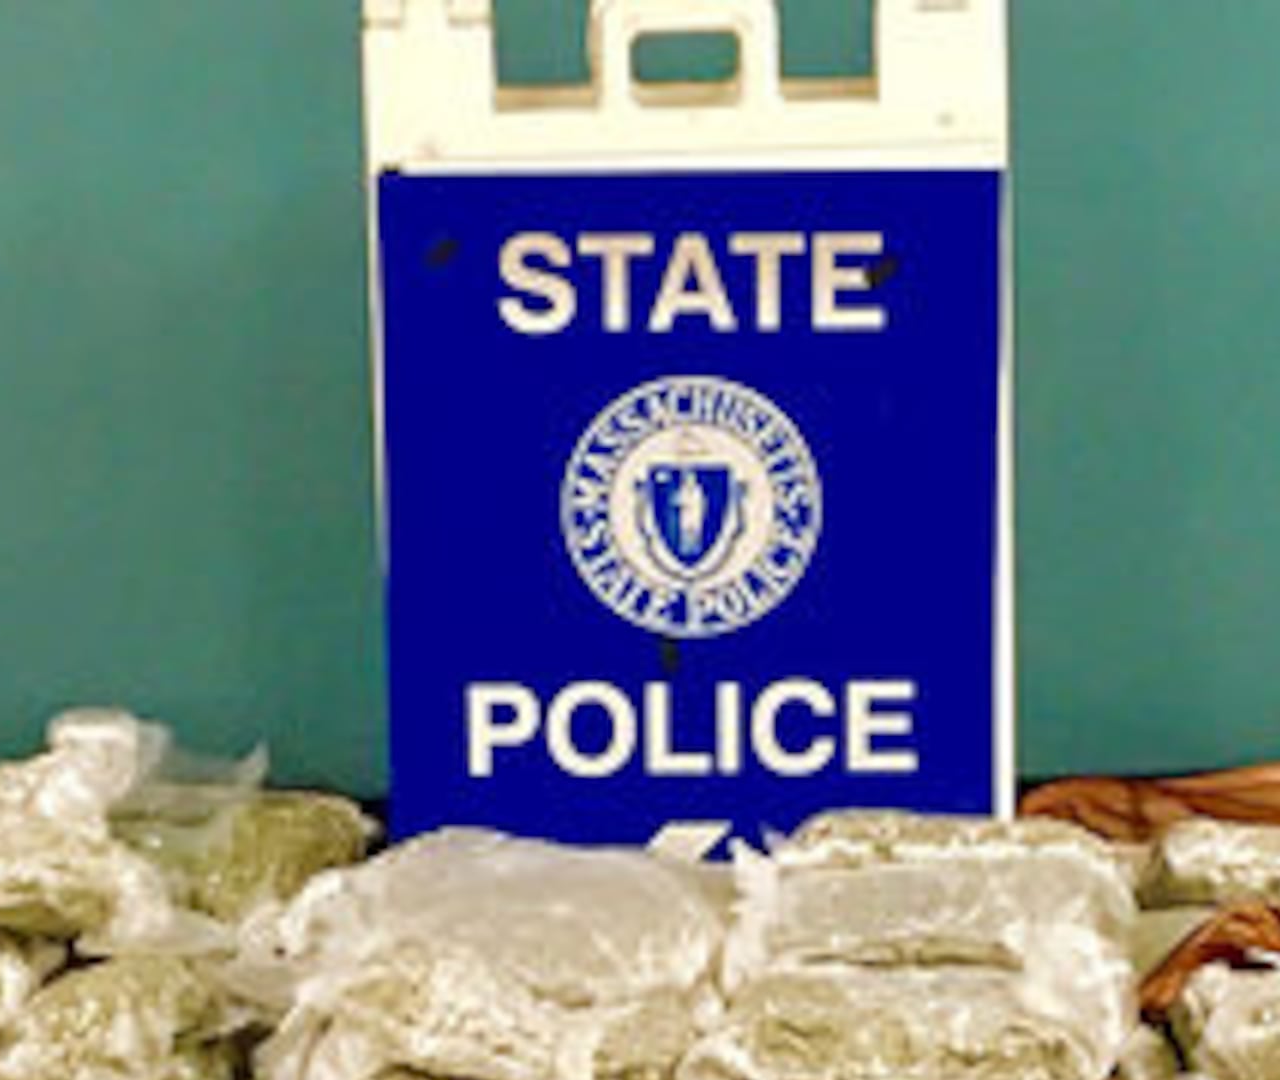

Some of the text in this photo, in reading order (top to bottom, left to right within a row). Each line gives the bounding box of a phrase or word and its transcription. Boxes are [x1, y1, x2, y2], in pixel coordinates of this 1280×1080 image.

[498, 232, 886, 334] STATE
[573, 385, 812, 506] MASSACHUSETTS
[572, 516, 812, 628] STATE POLICE
[466, 678, 918, 776] POLICE
